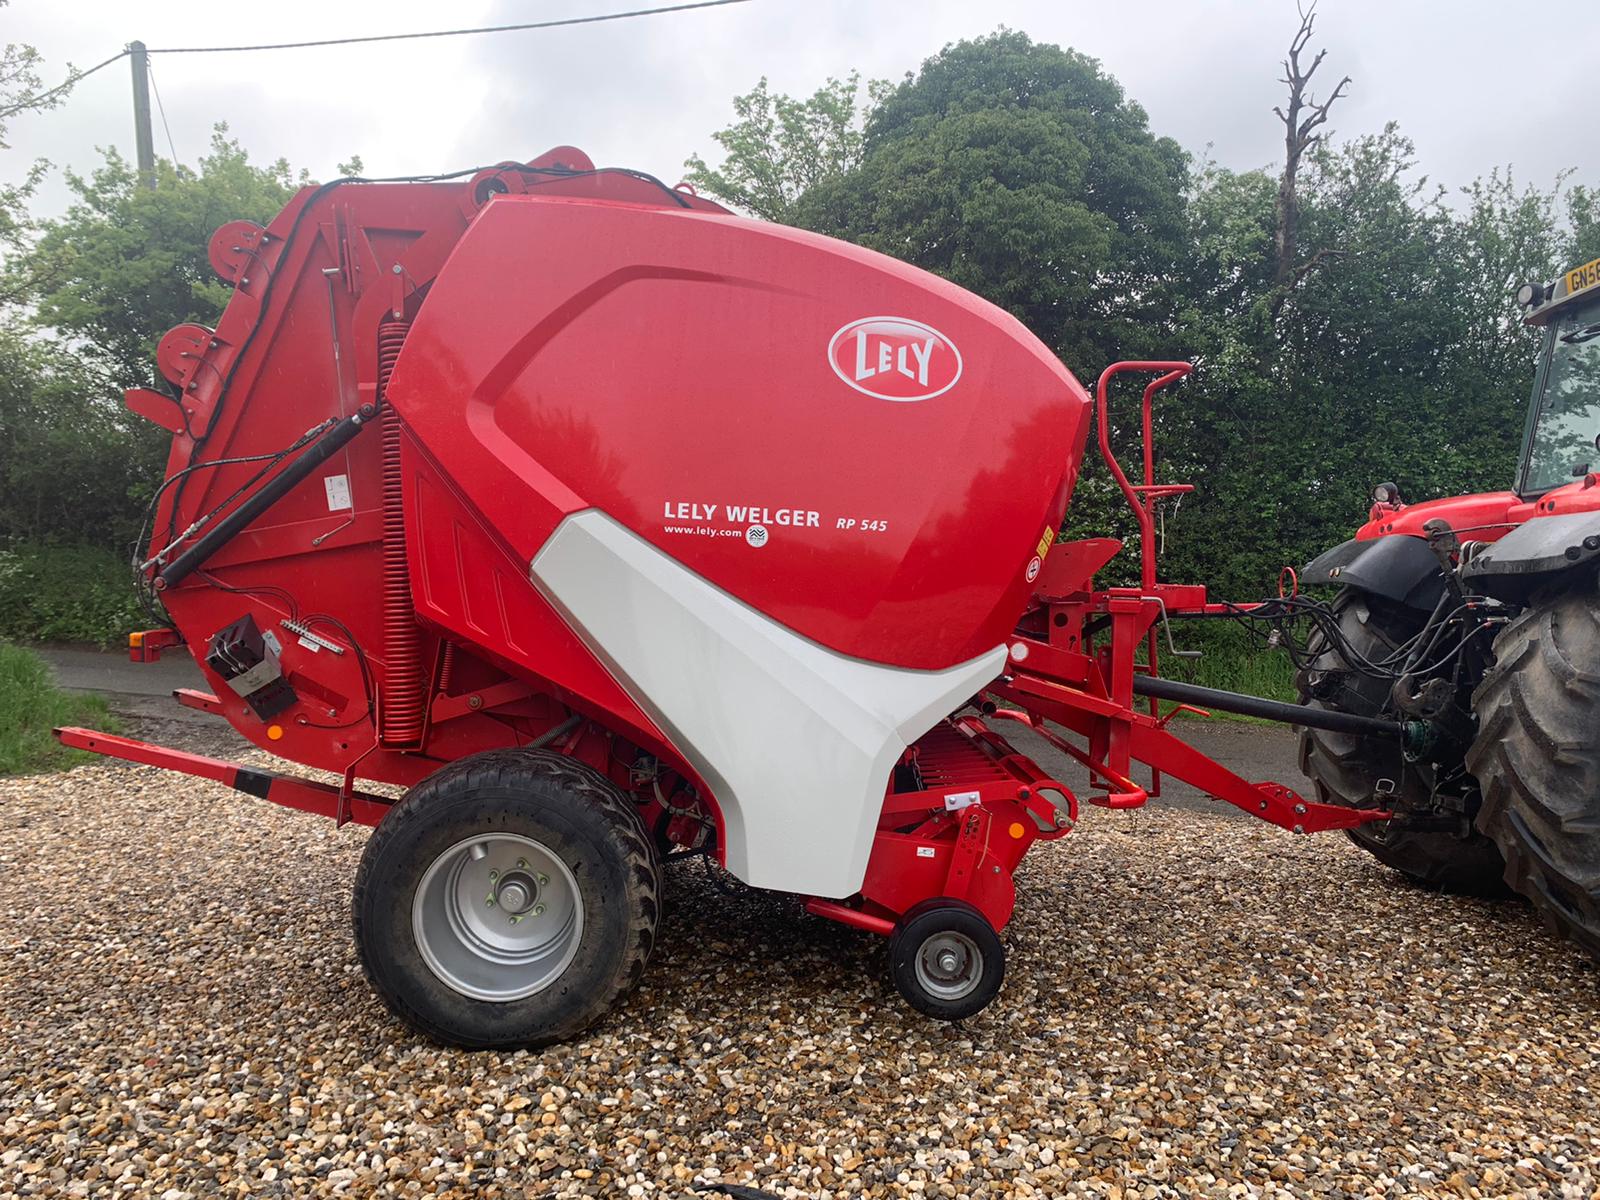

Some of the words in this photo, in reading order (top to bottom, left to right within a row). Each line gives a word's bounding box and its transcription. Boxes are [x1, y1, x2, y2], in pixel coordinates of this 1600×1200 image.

[856, 330, 935, 387] LELY
[664, 502, 717, 520] LELY
[726, 506, 820, 527] WELGER
[664, 525, 742, 537] www.lely.com
[836, 518, 856, 529] RP
[860, 519, 888, 532] 545
